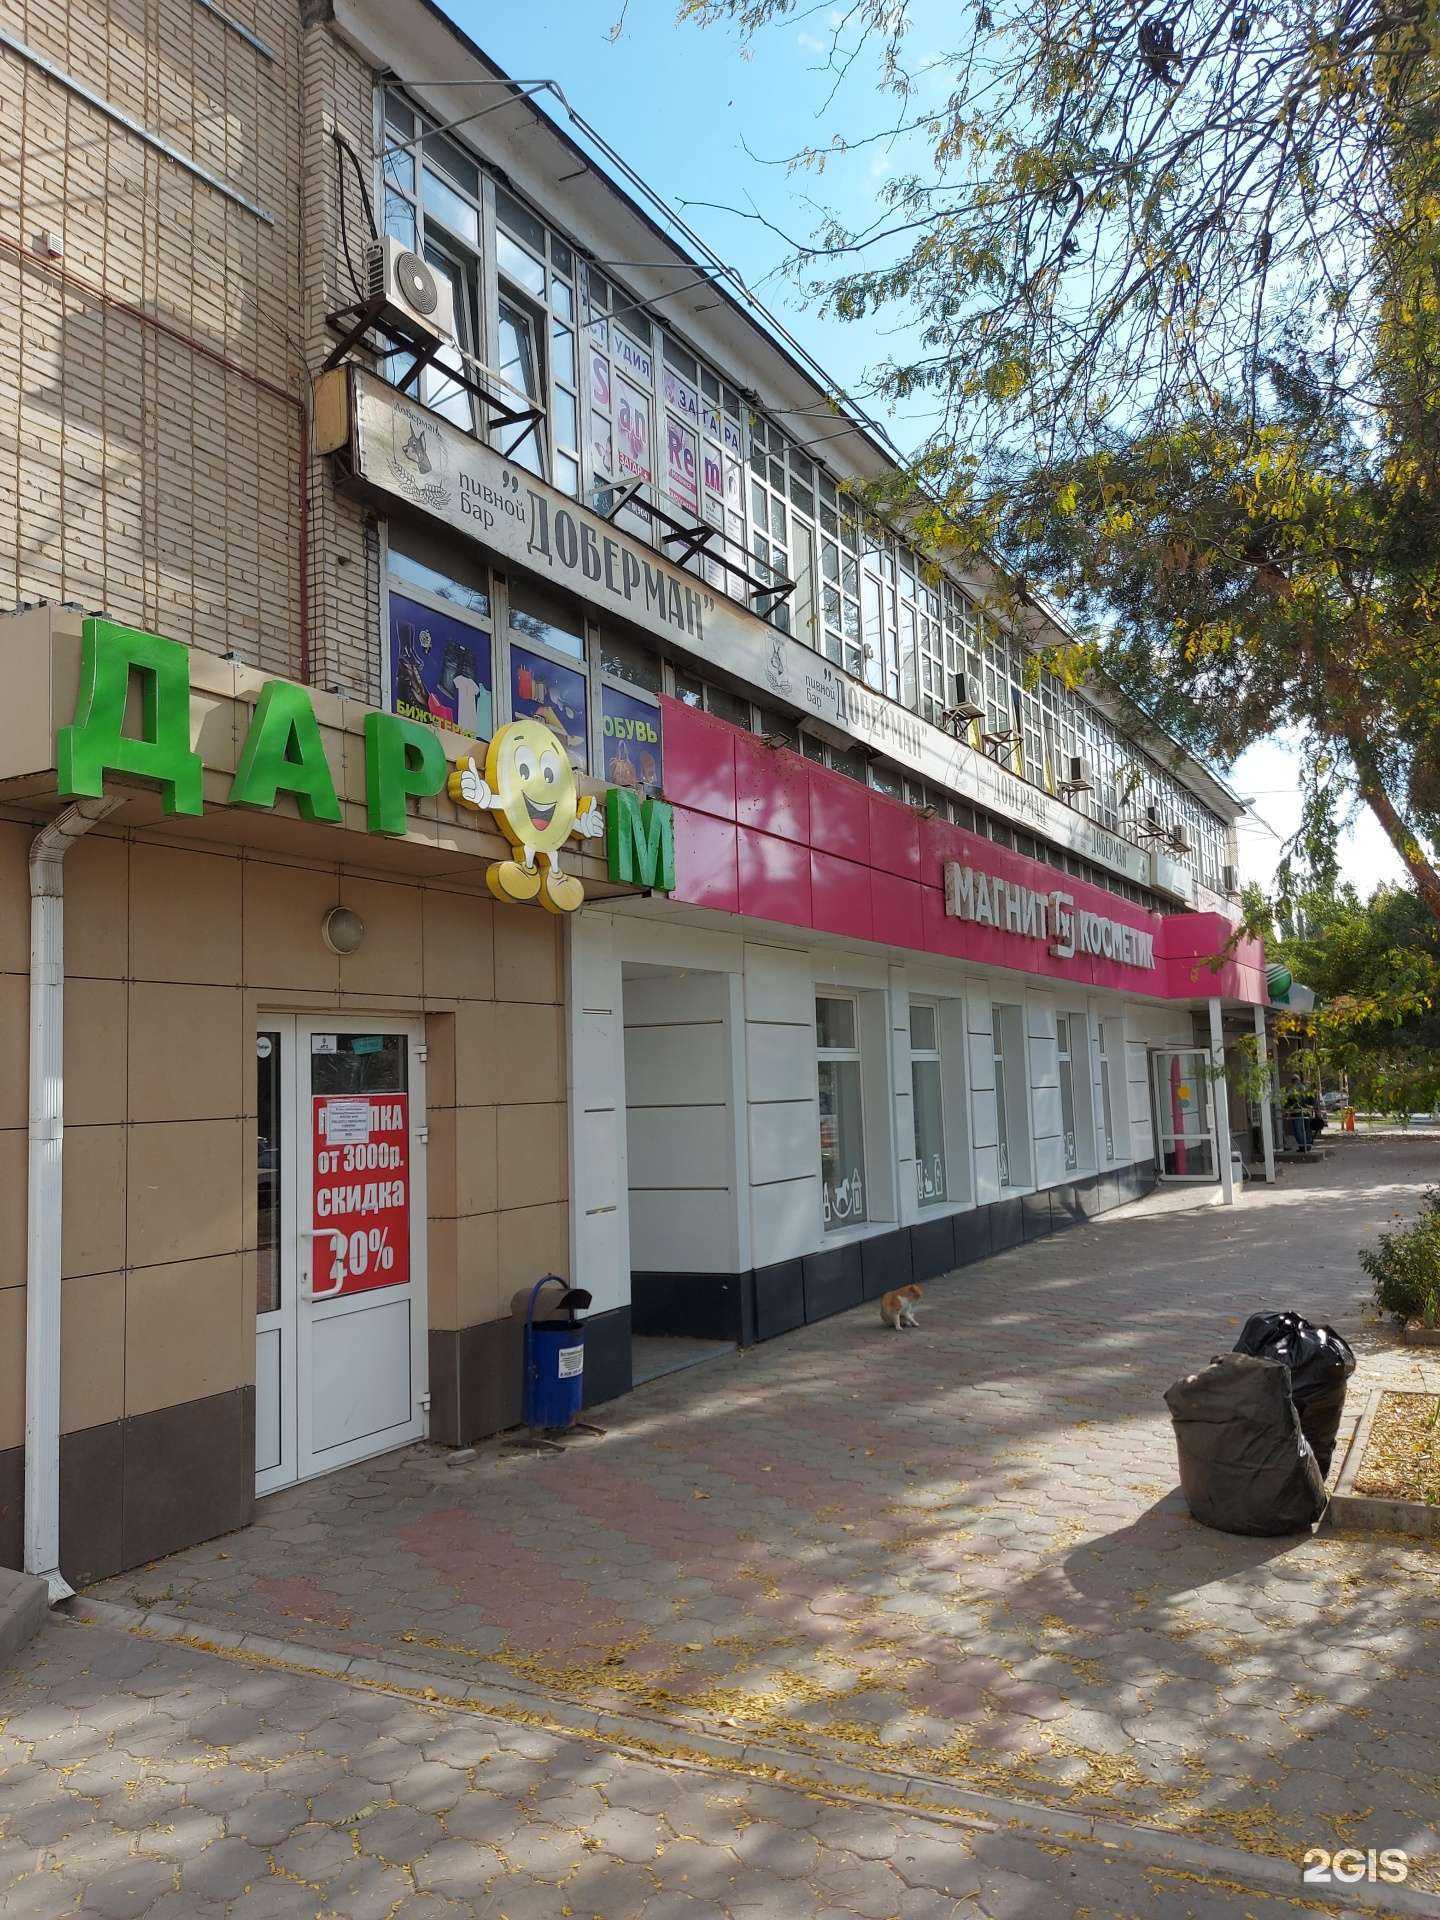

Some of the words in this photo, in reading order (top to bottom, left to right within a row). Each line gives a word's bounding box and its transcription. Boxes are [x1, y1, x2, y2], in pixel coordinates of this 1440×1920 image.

[459, 471, 526, 524] пивной
[602, 715, 657, 743] ОБУВЬ
[944, 861, 1049, 941] МАГНИТ
